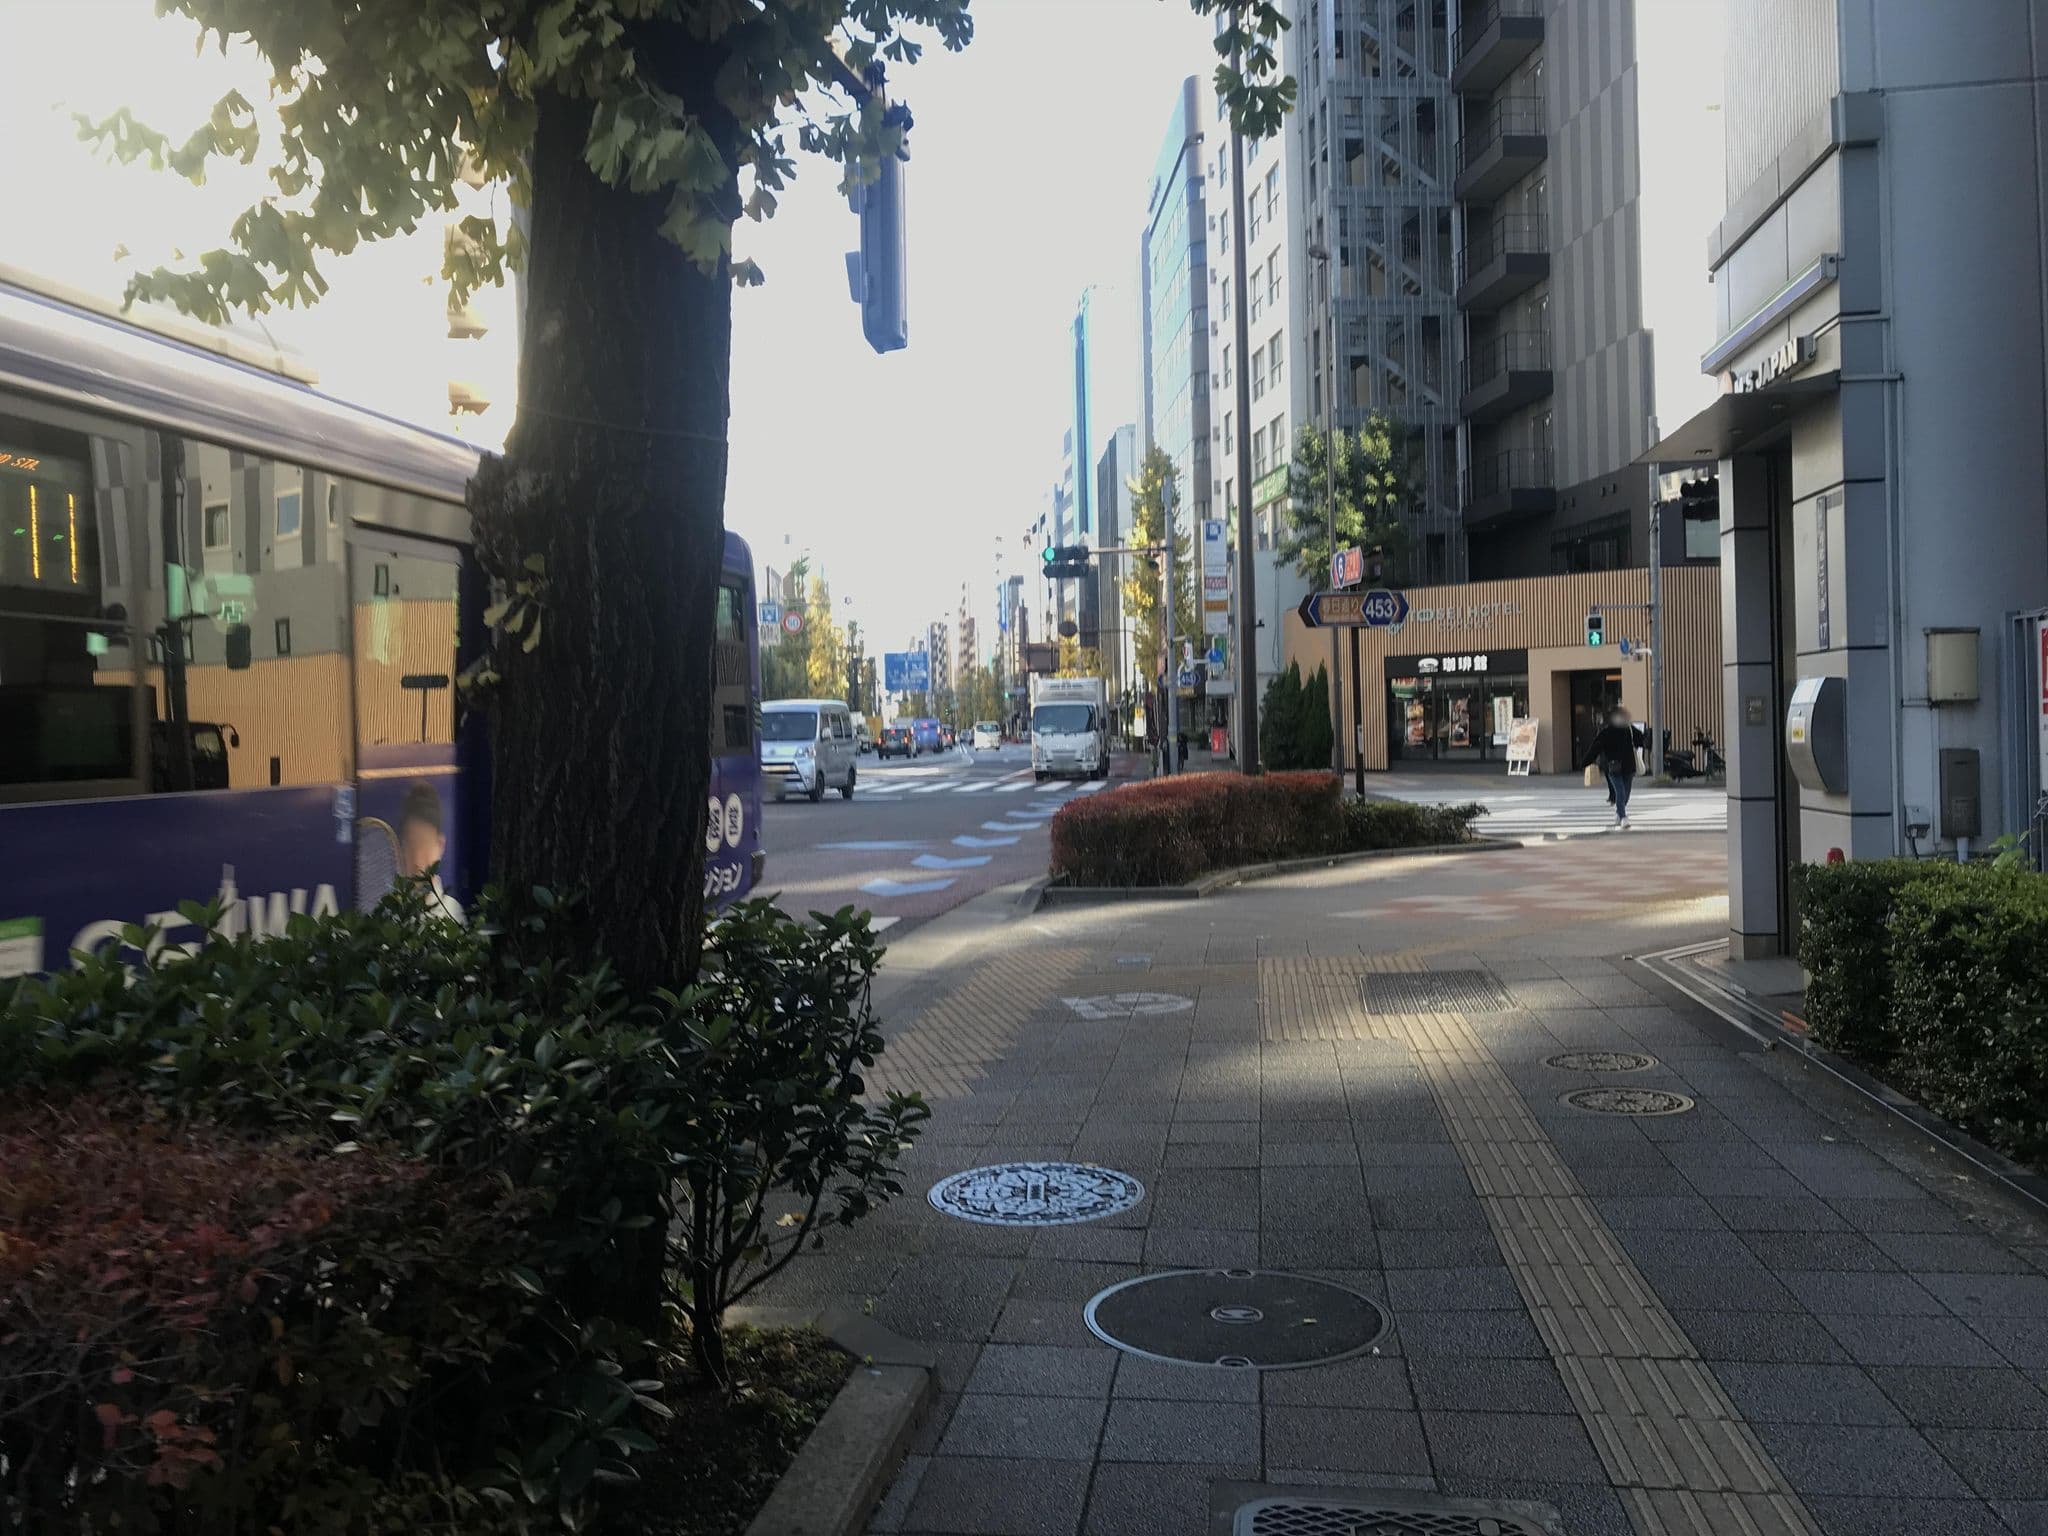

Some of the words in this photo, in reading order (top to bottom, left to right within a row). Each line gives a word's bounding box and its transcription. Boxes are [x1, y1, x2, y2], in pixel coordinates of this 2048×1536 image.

[1755, 336, 1798, 389] JAPAN
[1338, 558, 1344, 579] 6
[1365, 598, 1393, 619] 453
[1468, 601, 1523, 618] HOTEL
